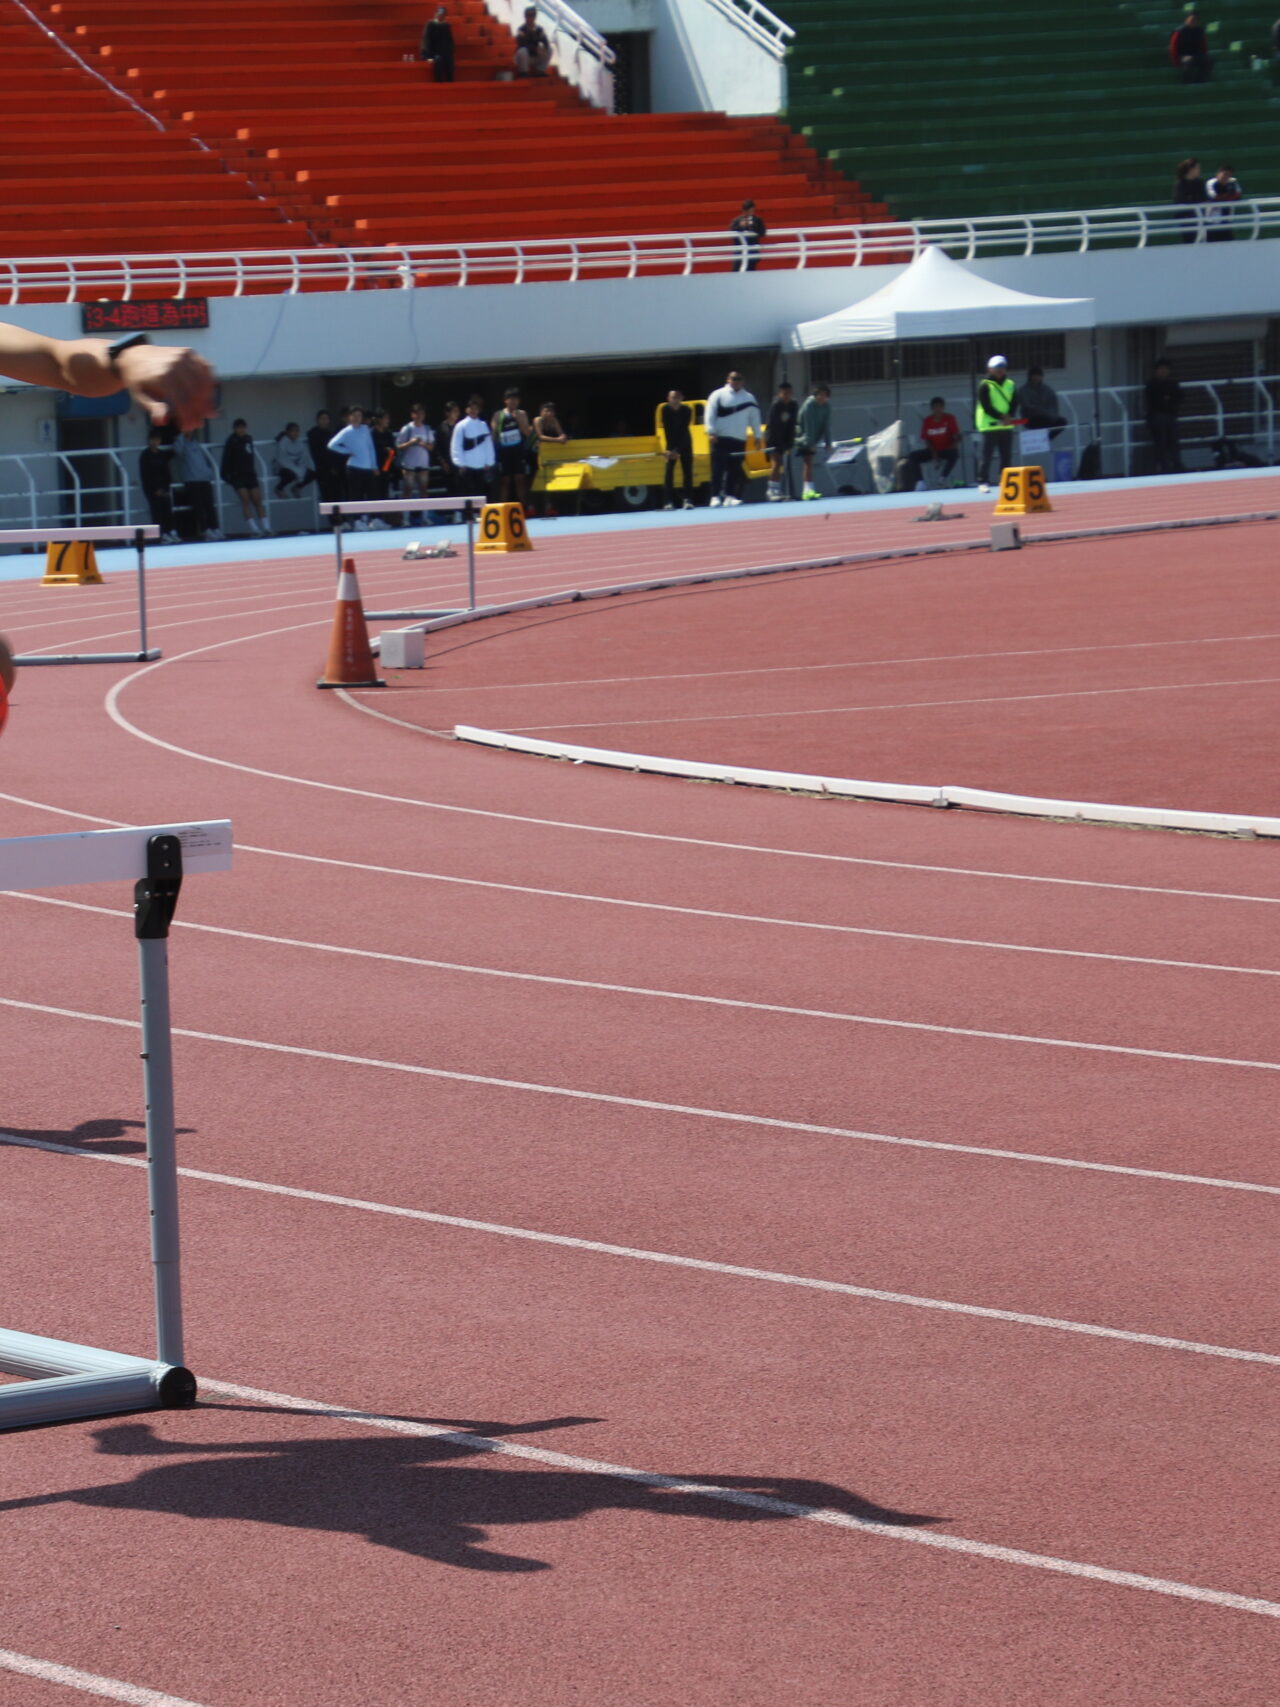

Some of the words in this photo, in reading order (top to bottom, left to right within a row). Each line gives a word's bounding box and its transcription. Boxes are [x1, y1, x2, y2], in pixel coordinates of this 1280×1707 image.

[1004, 471, 1020, 501] 5
[1028, 471, 1043, 500] 5
[483, 508, 500, 539] 6
[508, 507, 524, 538] 6
[51, 541, 72, 571] 7
[78, 541, 91, 570] 7
